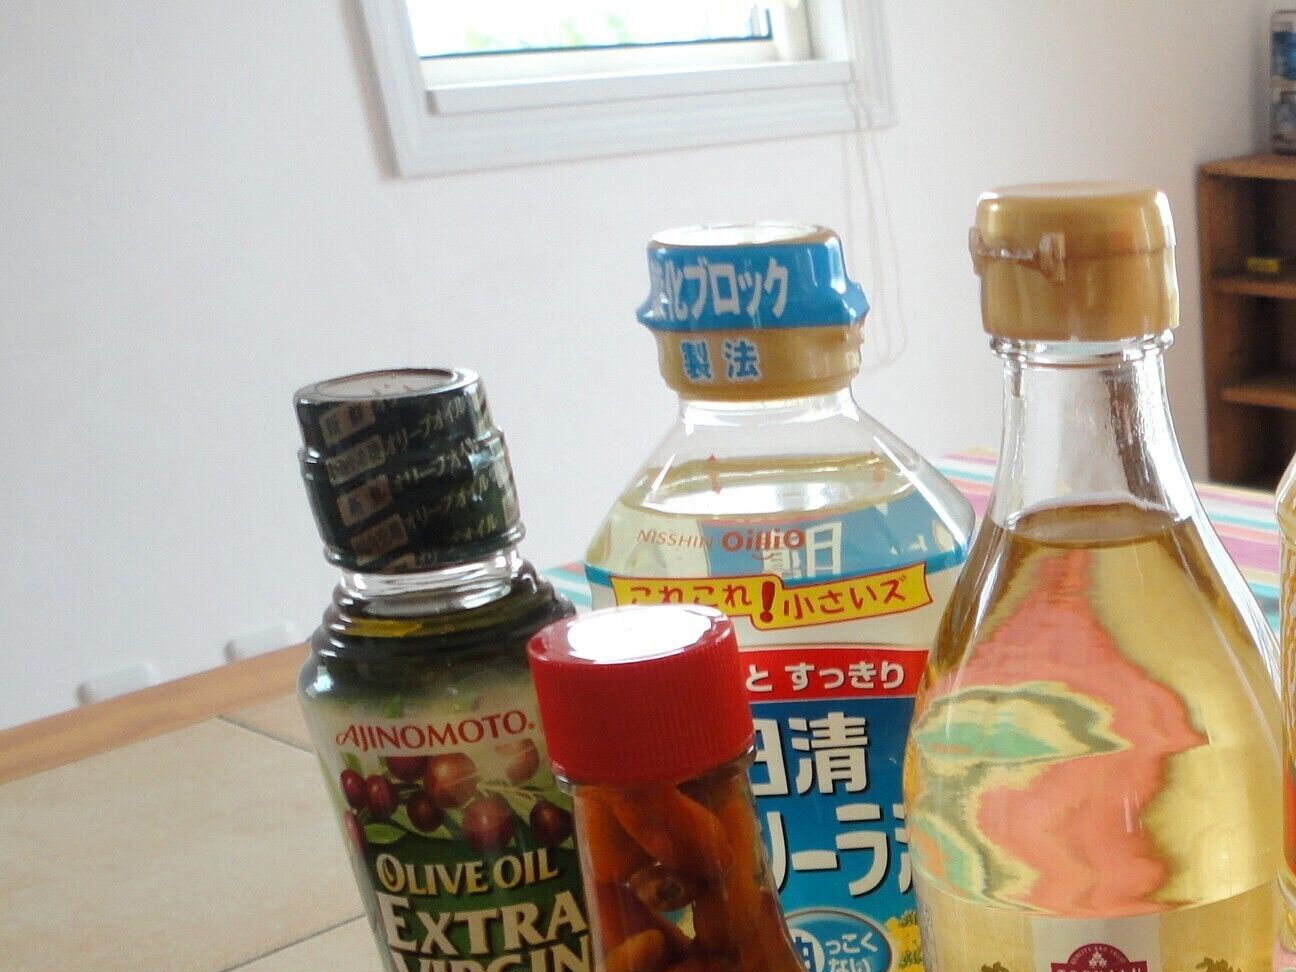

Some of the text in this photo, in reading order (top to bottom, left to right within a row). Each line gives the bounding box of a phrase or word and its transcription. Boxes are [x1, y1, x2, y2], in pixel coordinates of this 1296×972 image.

[636, 528, 713, 548] NISSHIN
[785, 660, 905, 691] すっきり
[336, 710, 530, 753] AJINOMOTO
[375, 847, 559, 898] OLIVE OIL
[374, 890, 587, 958] EXTRA
